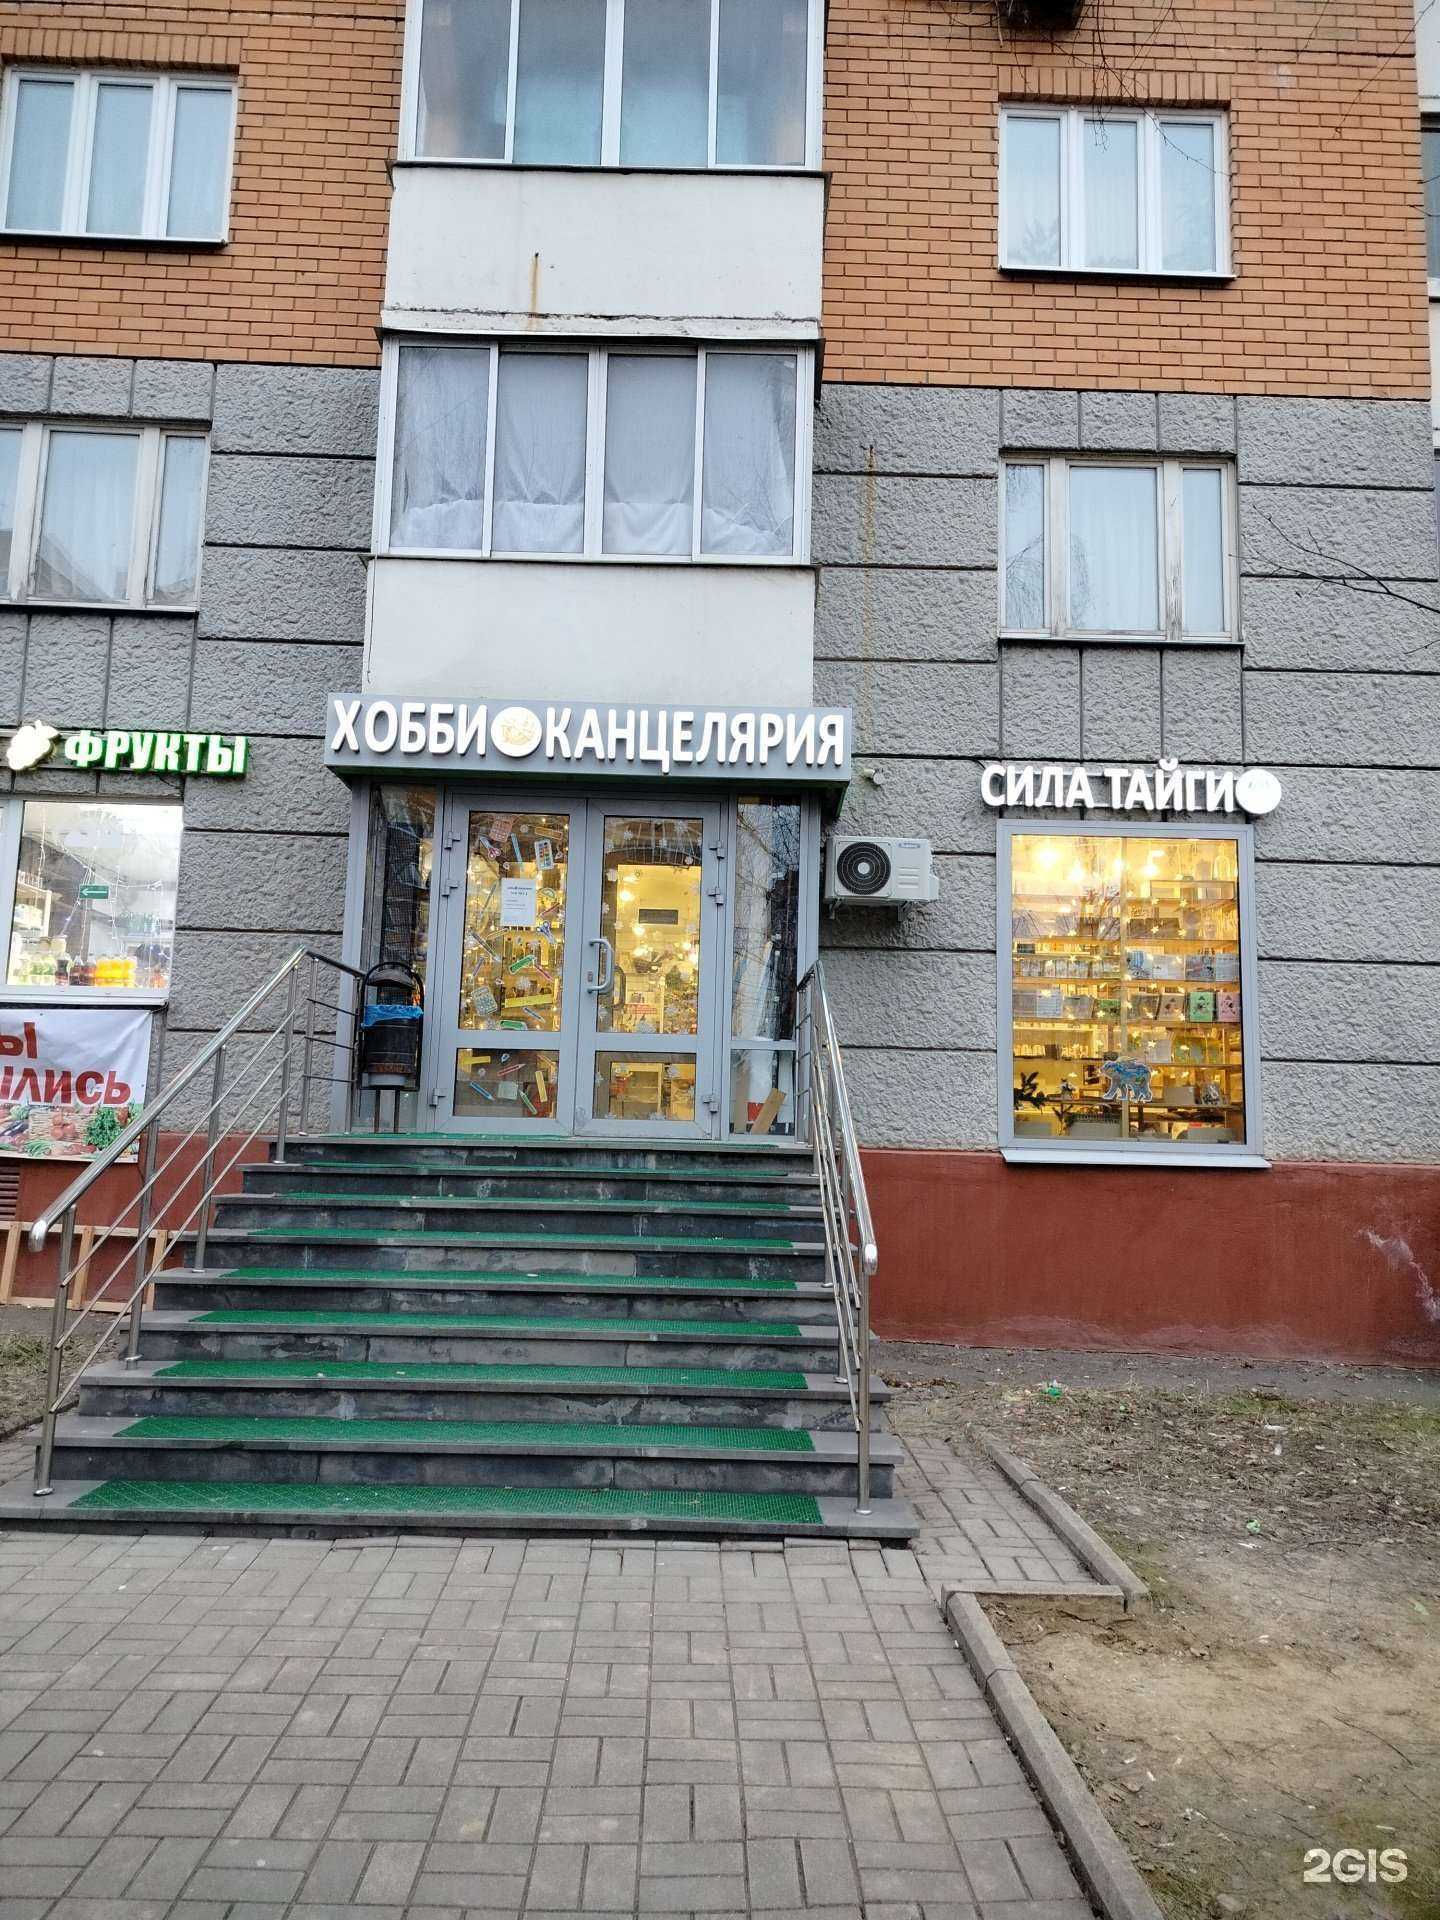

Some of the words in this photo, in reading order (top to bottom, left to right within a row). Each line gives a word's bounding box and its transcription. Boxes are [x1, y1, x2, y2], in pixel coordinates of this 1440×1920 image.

[64, 729, 249, 776] ФРУКТЫ
[330, 699, 488, 756] ХОББИ
[545, 706, 845, 774] КАНЦЕЛЯРИЯ
[980, 764, 1094, 809] СИЛА
[1103, 758, 1235, 812] ТАЙГИ
